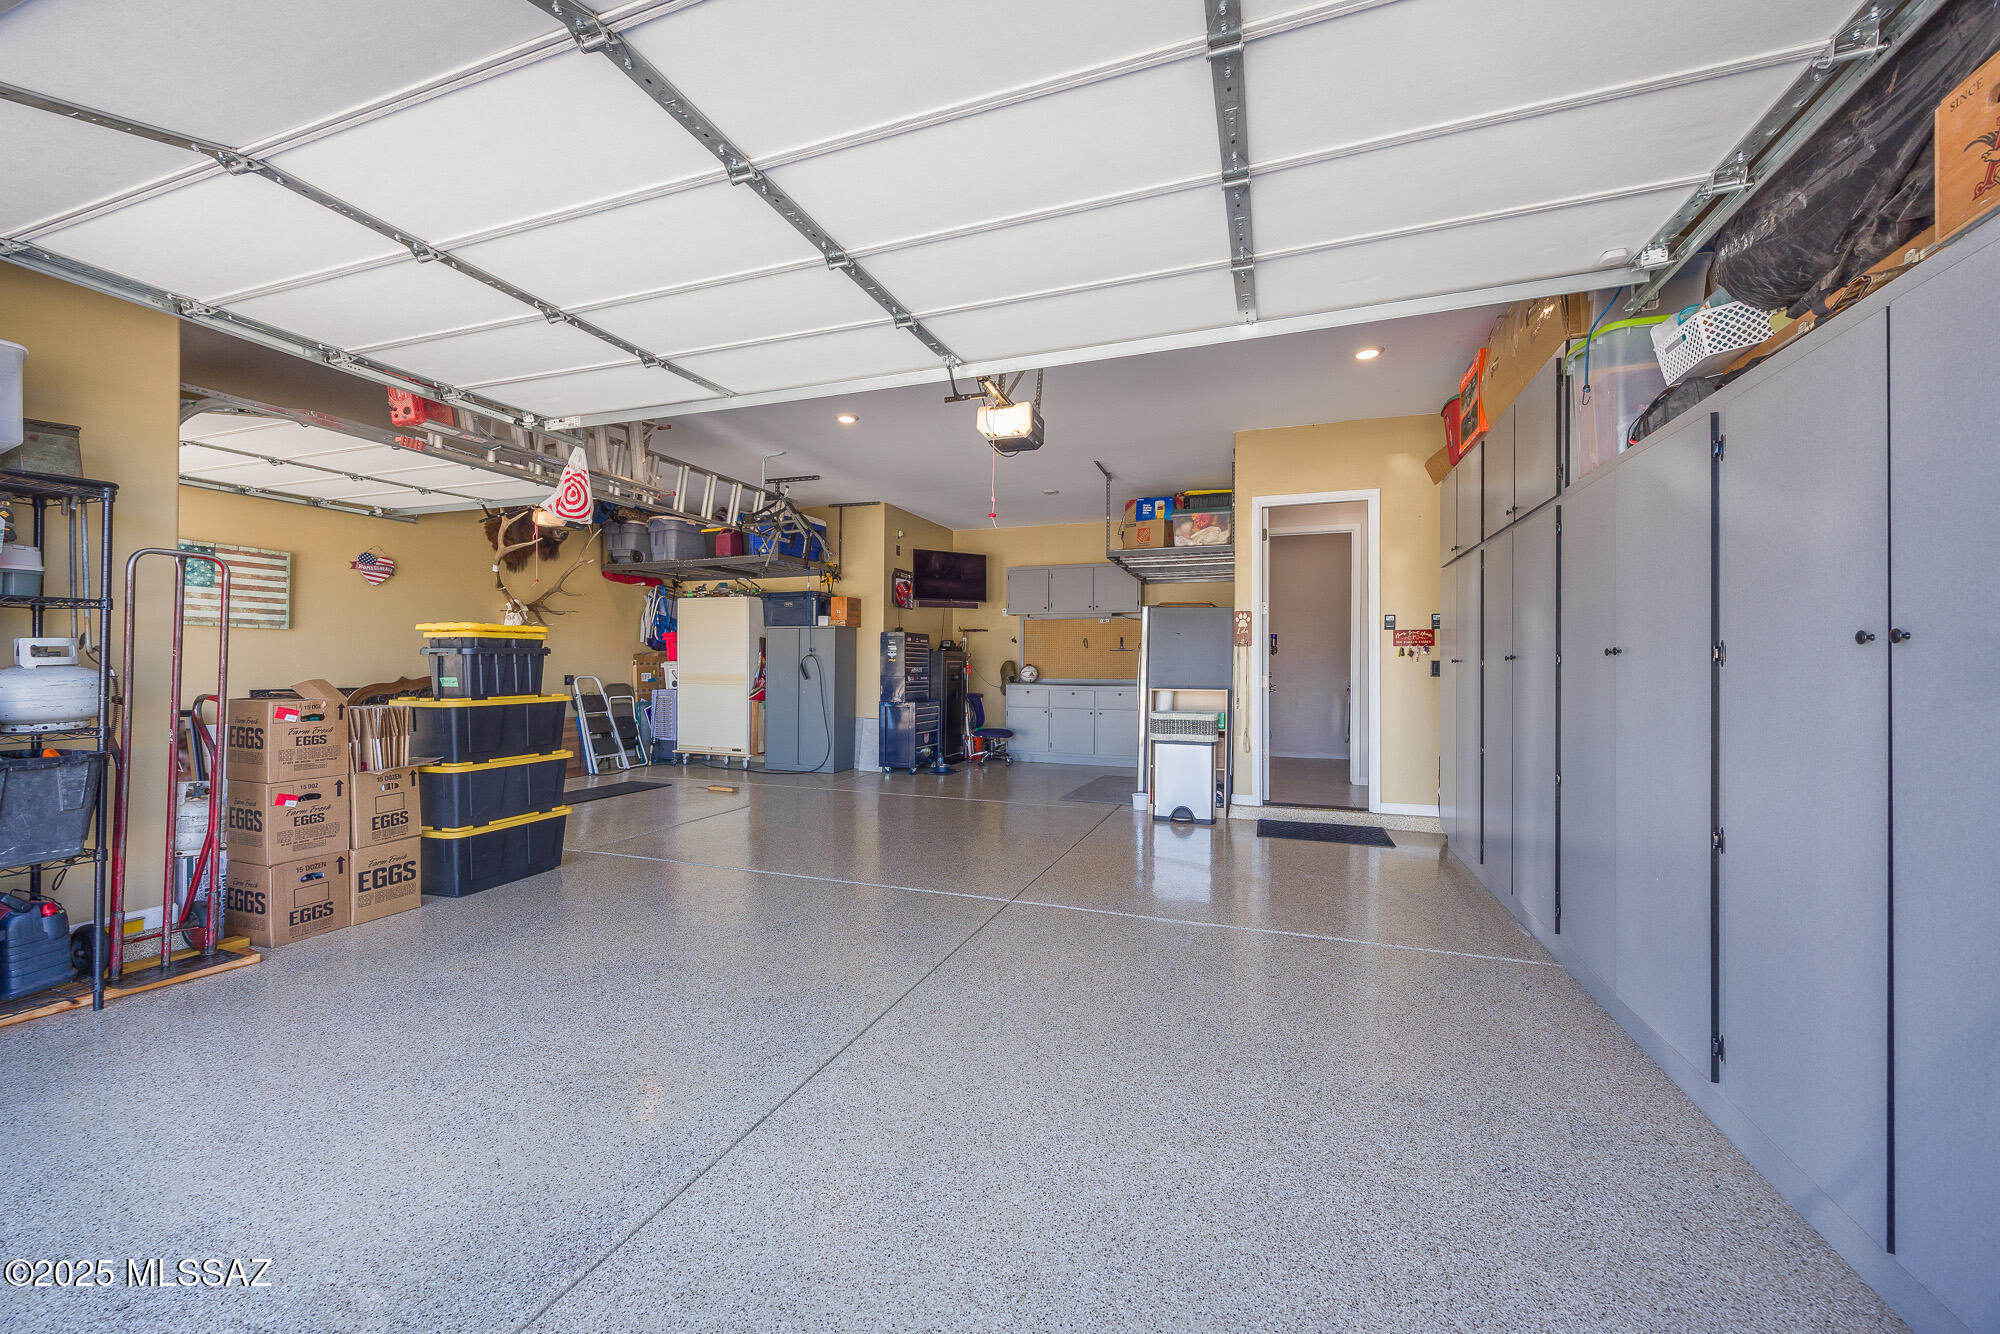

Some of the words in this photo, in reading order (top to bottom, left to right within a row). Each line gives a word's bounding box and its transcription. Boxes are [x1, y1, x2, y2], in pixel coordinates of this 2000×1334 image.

[1949, 77, 1984, 112] SINCE
[229, 725, 264, 750] EGGS
[288, 727, 310, 736] Farm
[312, 726, 334, 734] Fresh
[295, 734, 327, 747] EGGS
[384, 773, 402, 782] DOZEN
[229, 806, 263, 832] EGGS
[286, 807, 308, 817] Farm
[310, 804, 332, 813] Fresh
[293, 812, 325, 827] EGGS
[371, 810, 409, 831] EGGS
[305, 861, 327, 872] DOZEN
[368, 859, 388, 868] Farm
[358, 860, 417, 893] EGGS
[227, 887, 266, 915] EGGS
[289, 901, 334, 926] EGGS
